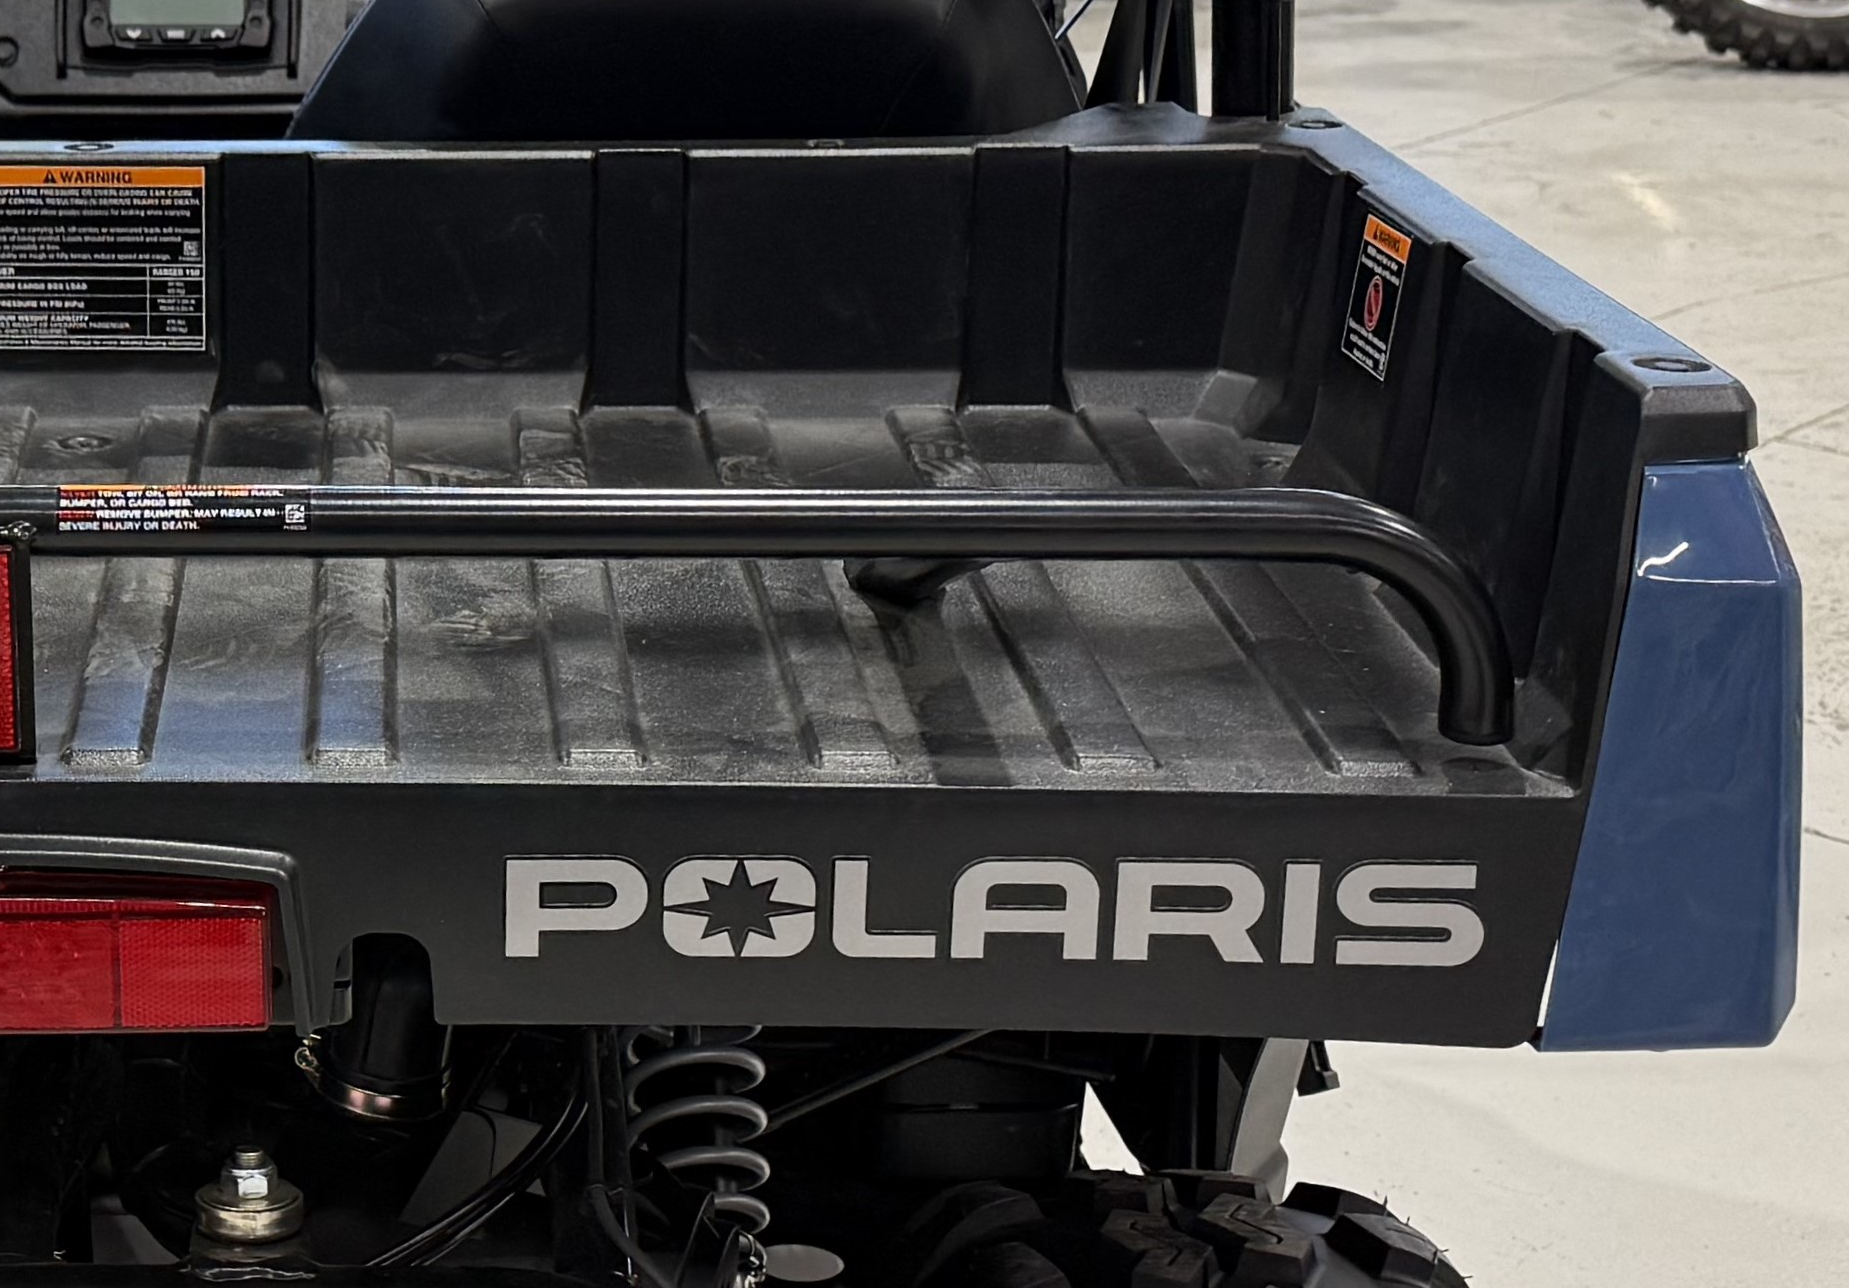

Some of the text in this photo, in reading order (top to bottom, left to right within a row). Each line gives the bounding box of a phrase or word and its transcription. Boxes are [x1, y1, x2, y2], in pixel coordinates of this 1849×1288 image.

[60, 172, 133, 184] WARNING
[127, 498, 167, 508] CARGO
[95, 509, 142, 519] REMOVE
[193, 509, 219, 519] MAY
[220, 509, 262, 519] RESULT
[59, 521, 100, 531] SEVERE
[101, 521, 141, 531] INJURY
[143, 521, 159, 531] OR
[505, 858, 1485, 968] POLARIS
